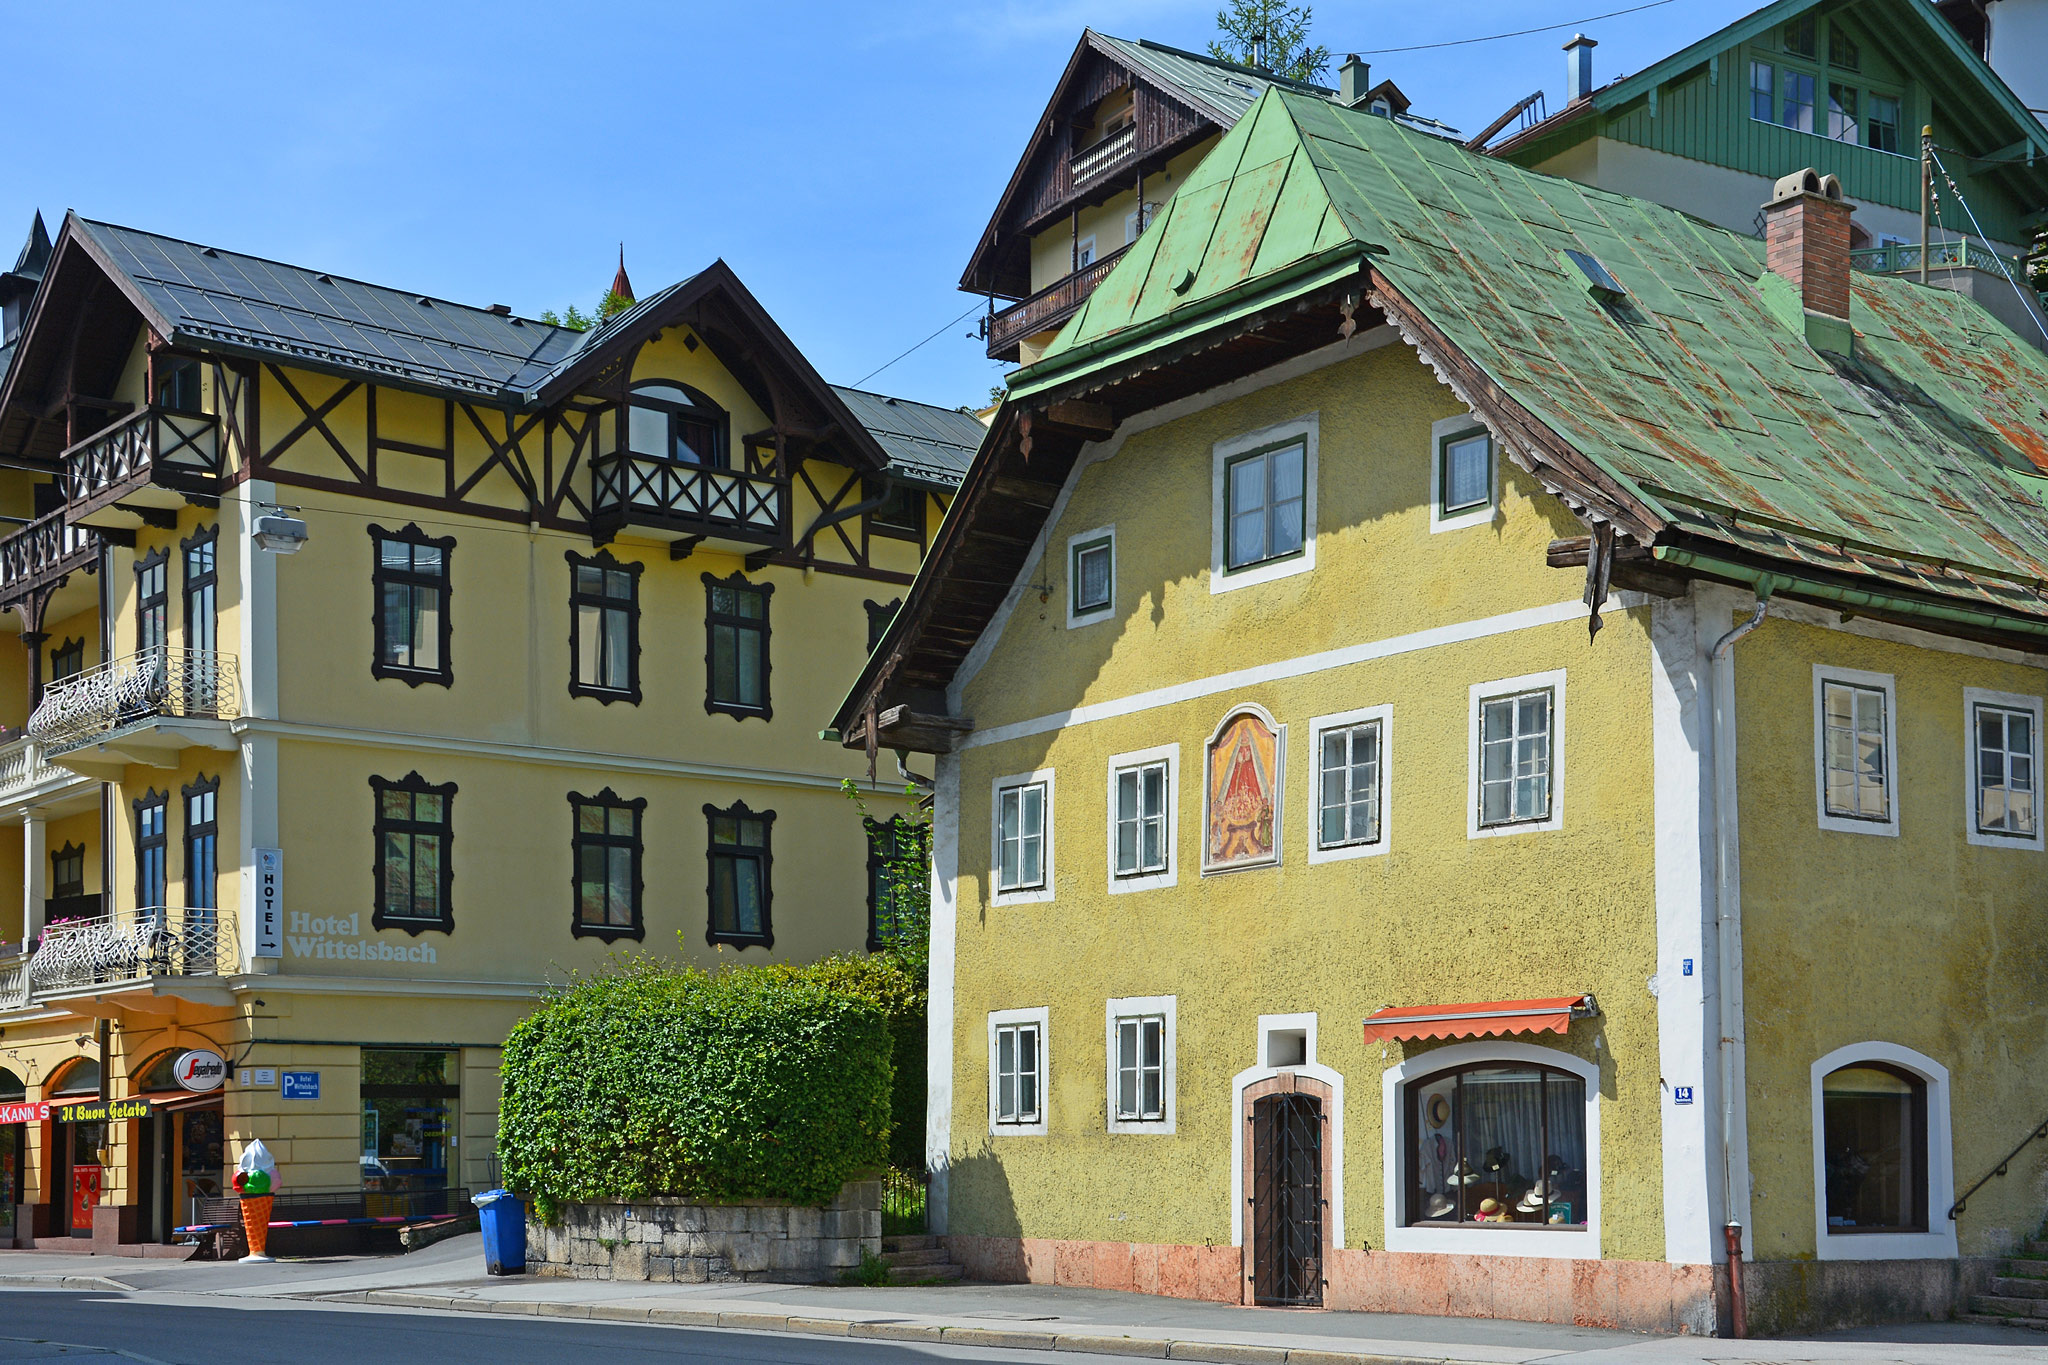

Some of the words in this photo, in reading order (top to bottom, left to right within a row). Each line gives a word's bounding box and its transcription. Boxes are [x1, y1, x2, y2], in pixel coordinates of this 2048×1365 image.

[264, 874, 274, 935] HOTEL
[290, 911, 359, 936] Hotel
[286, 936, 437, 964] Wittelsbach
[184, 1058, 222, 1080] Segafredo
[284, 1075, 295, 1095] P
[1677, 1088, 1690, 1098] 14
[76, 1104, 106, 1120] Buon
[109, 1101, 147, 1119] Gelato
